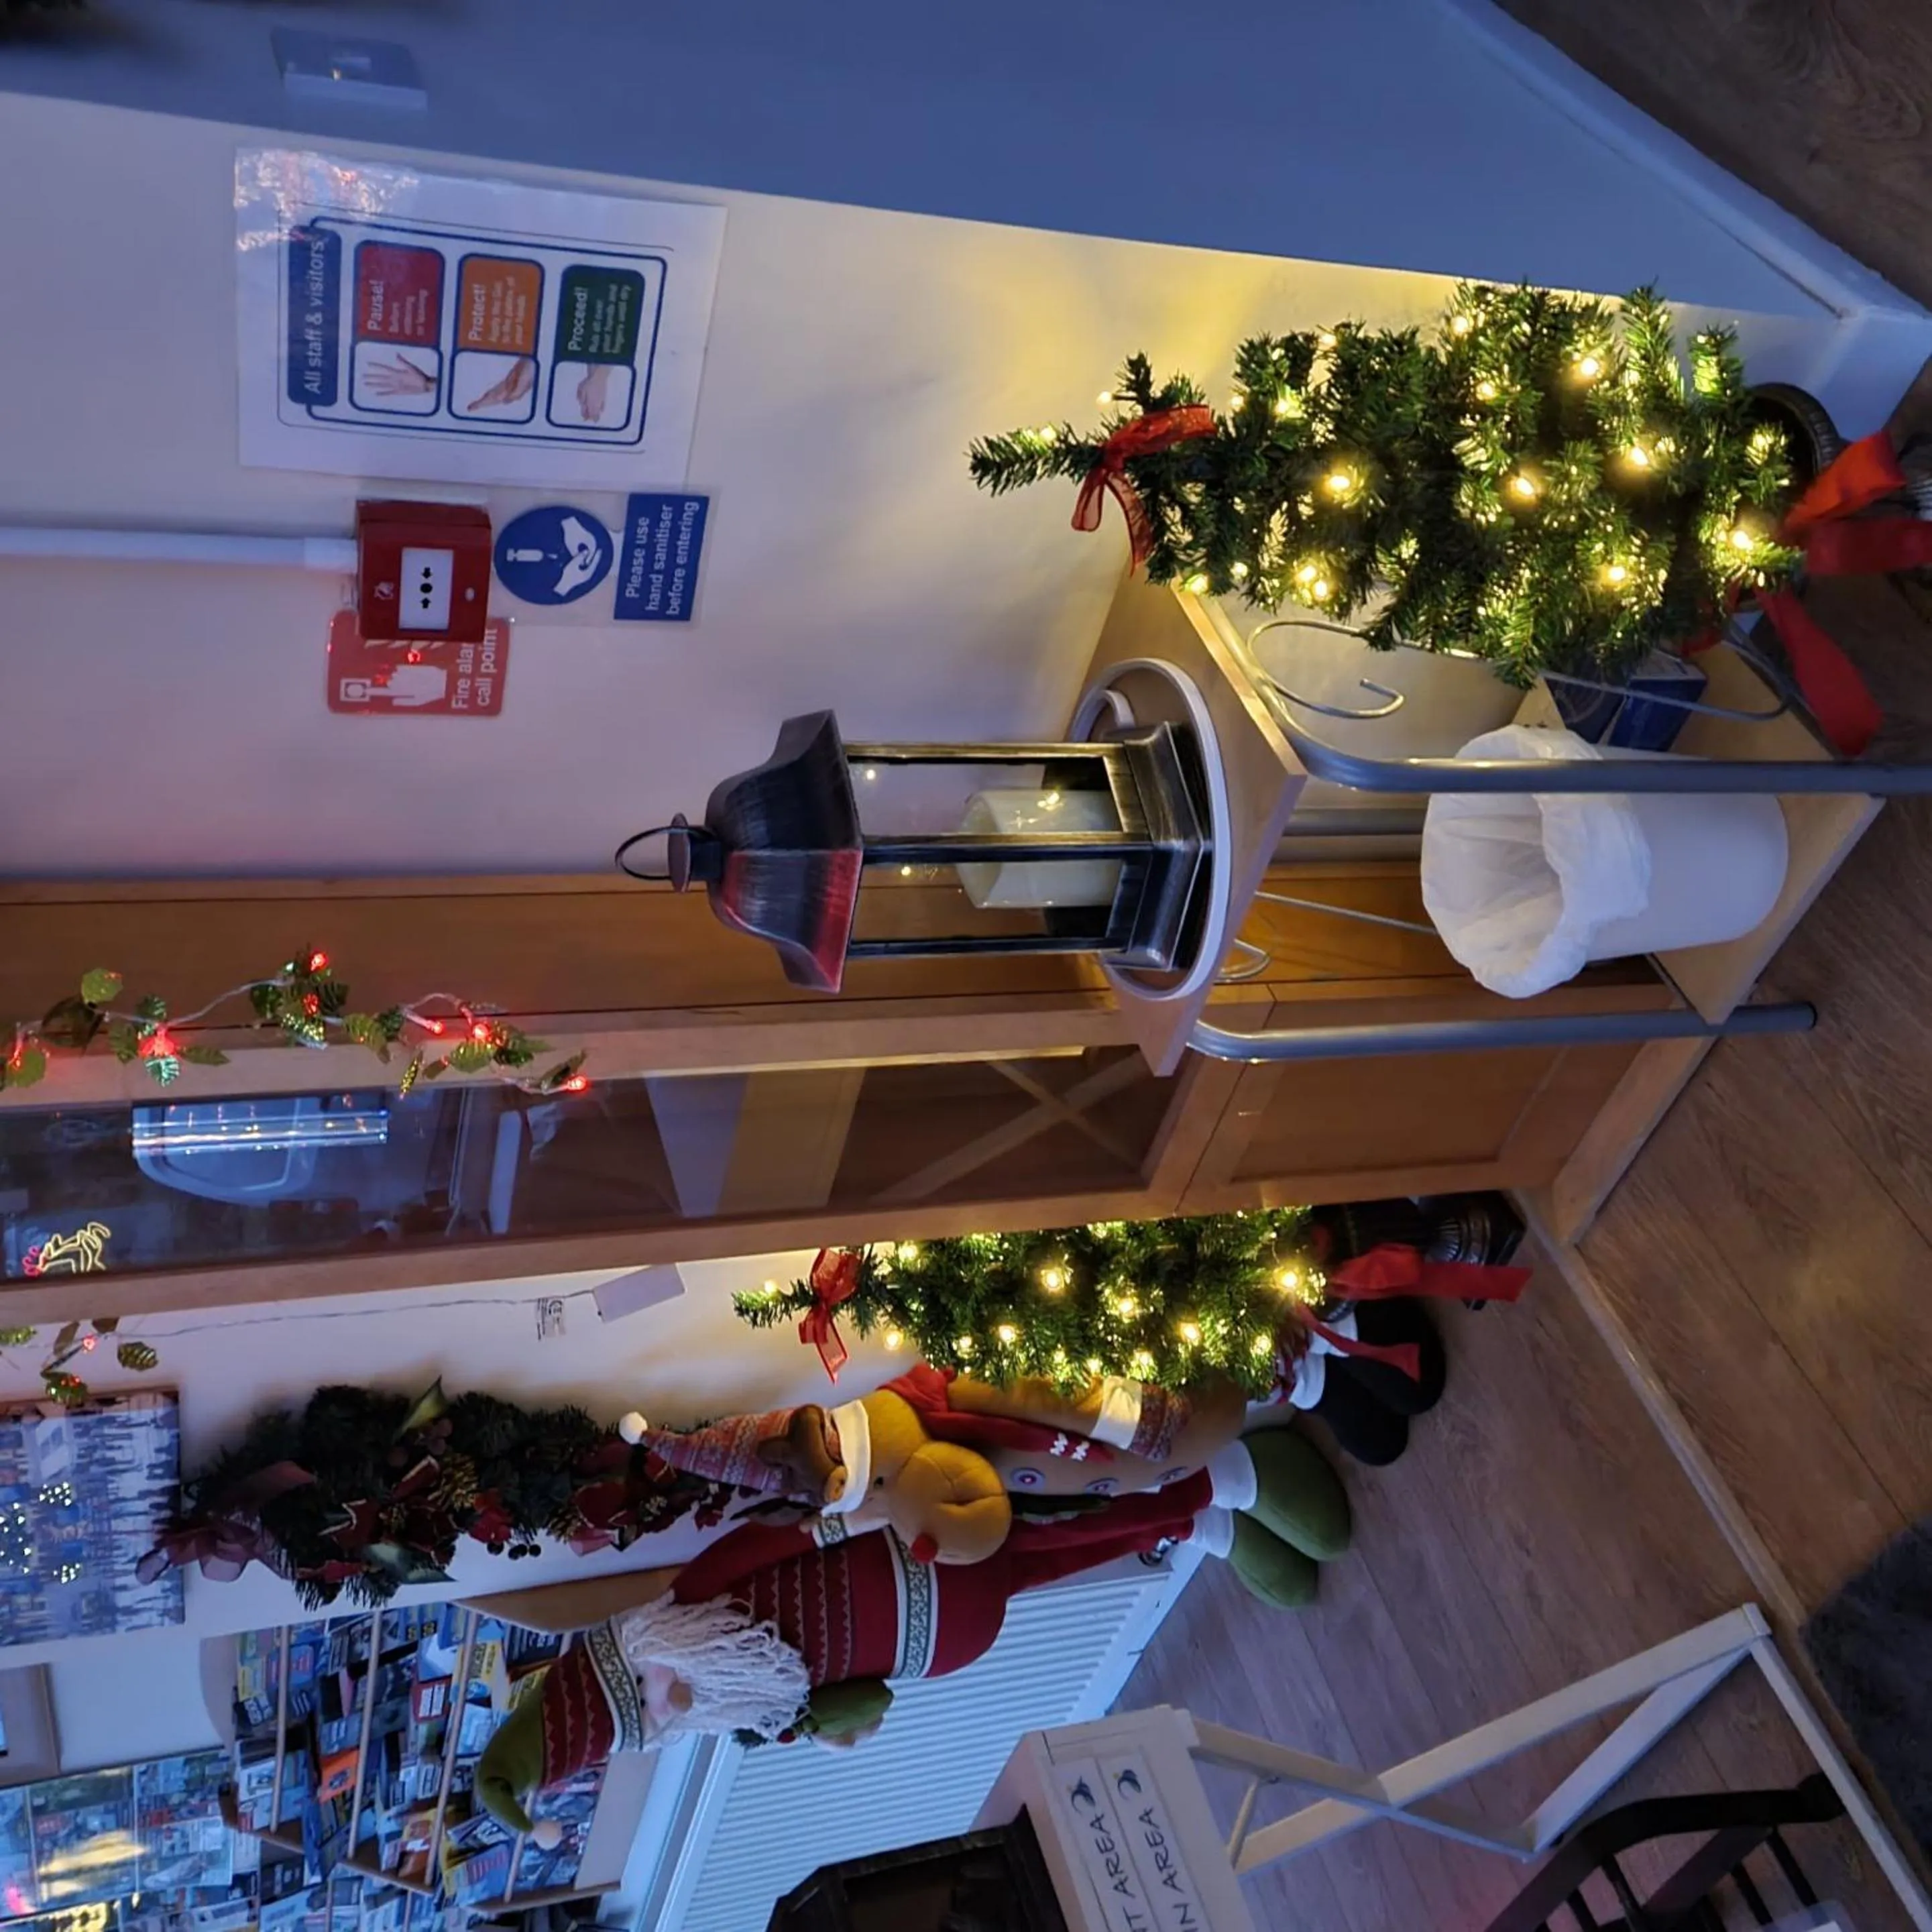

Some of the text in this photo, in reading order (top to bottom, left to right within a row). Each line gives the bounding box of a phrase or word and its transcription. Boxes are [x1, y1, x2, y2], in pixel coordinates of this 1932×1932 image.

[303, 240, 325, 394] All staff & visitors
[367, 279, 384, 331] Pause!
[468, 284, 487, 341] Protect!
[567, 286, 588, 351] Proceed!
[625, 516, 650, 598] Please use
[644, 504, 673, 610] hand sanitiser
[664, 501, 700, 615] before entering
[451, 642, 475, 709] Fire alar
[475, 628, 498, 705] call point
[1089, 1813, 1136, 1898] AREA
[1138, 1806, 1184, 1894] AREA
